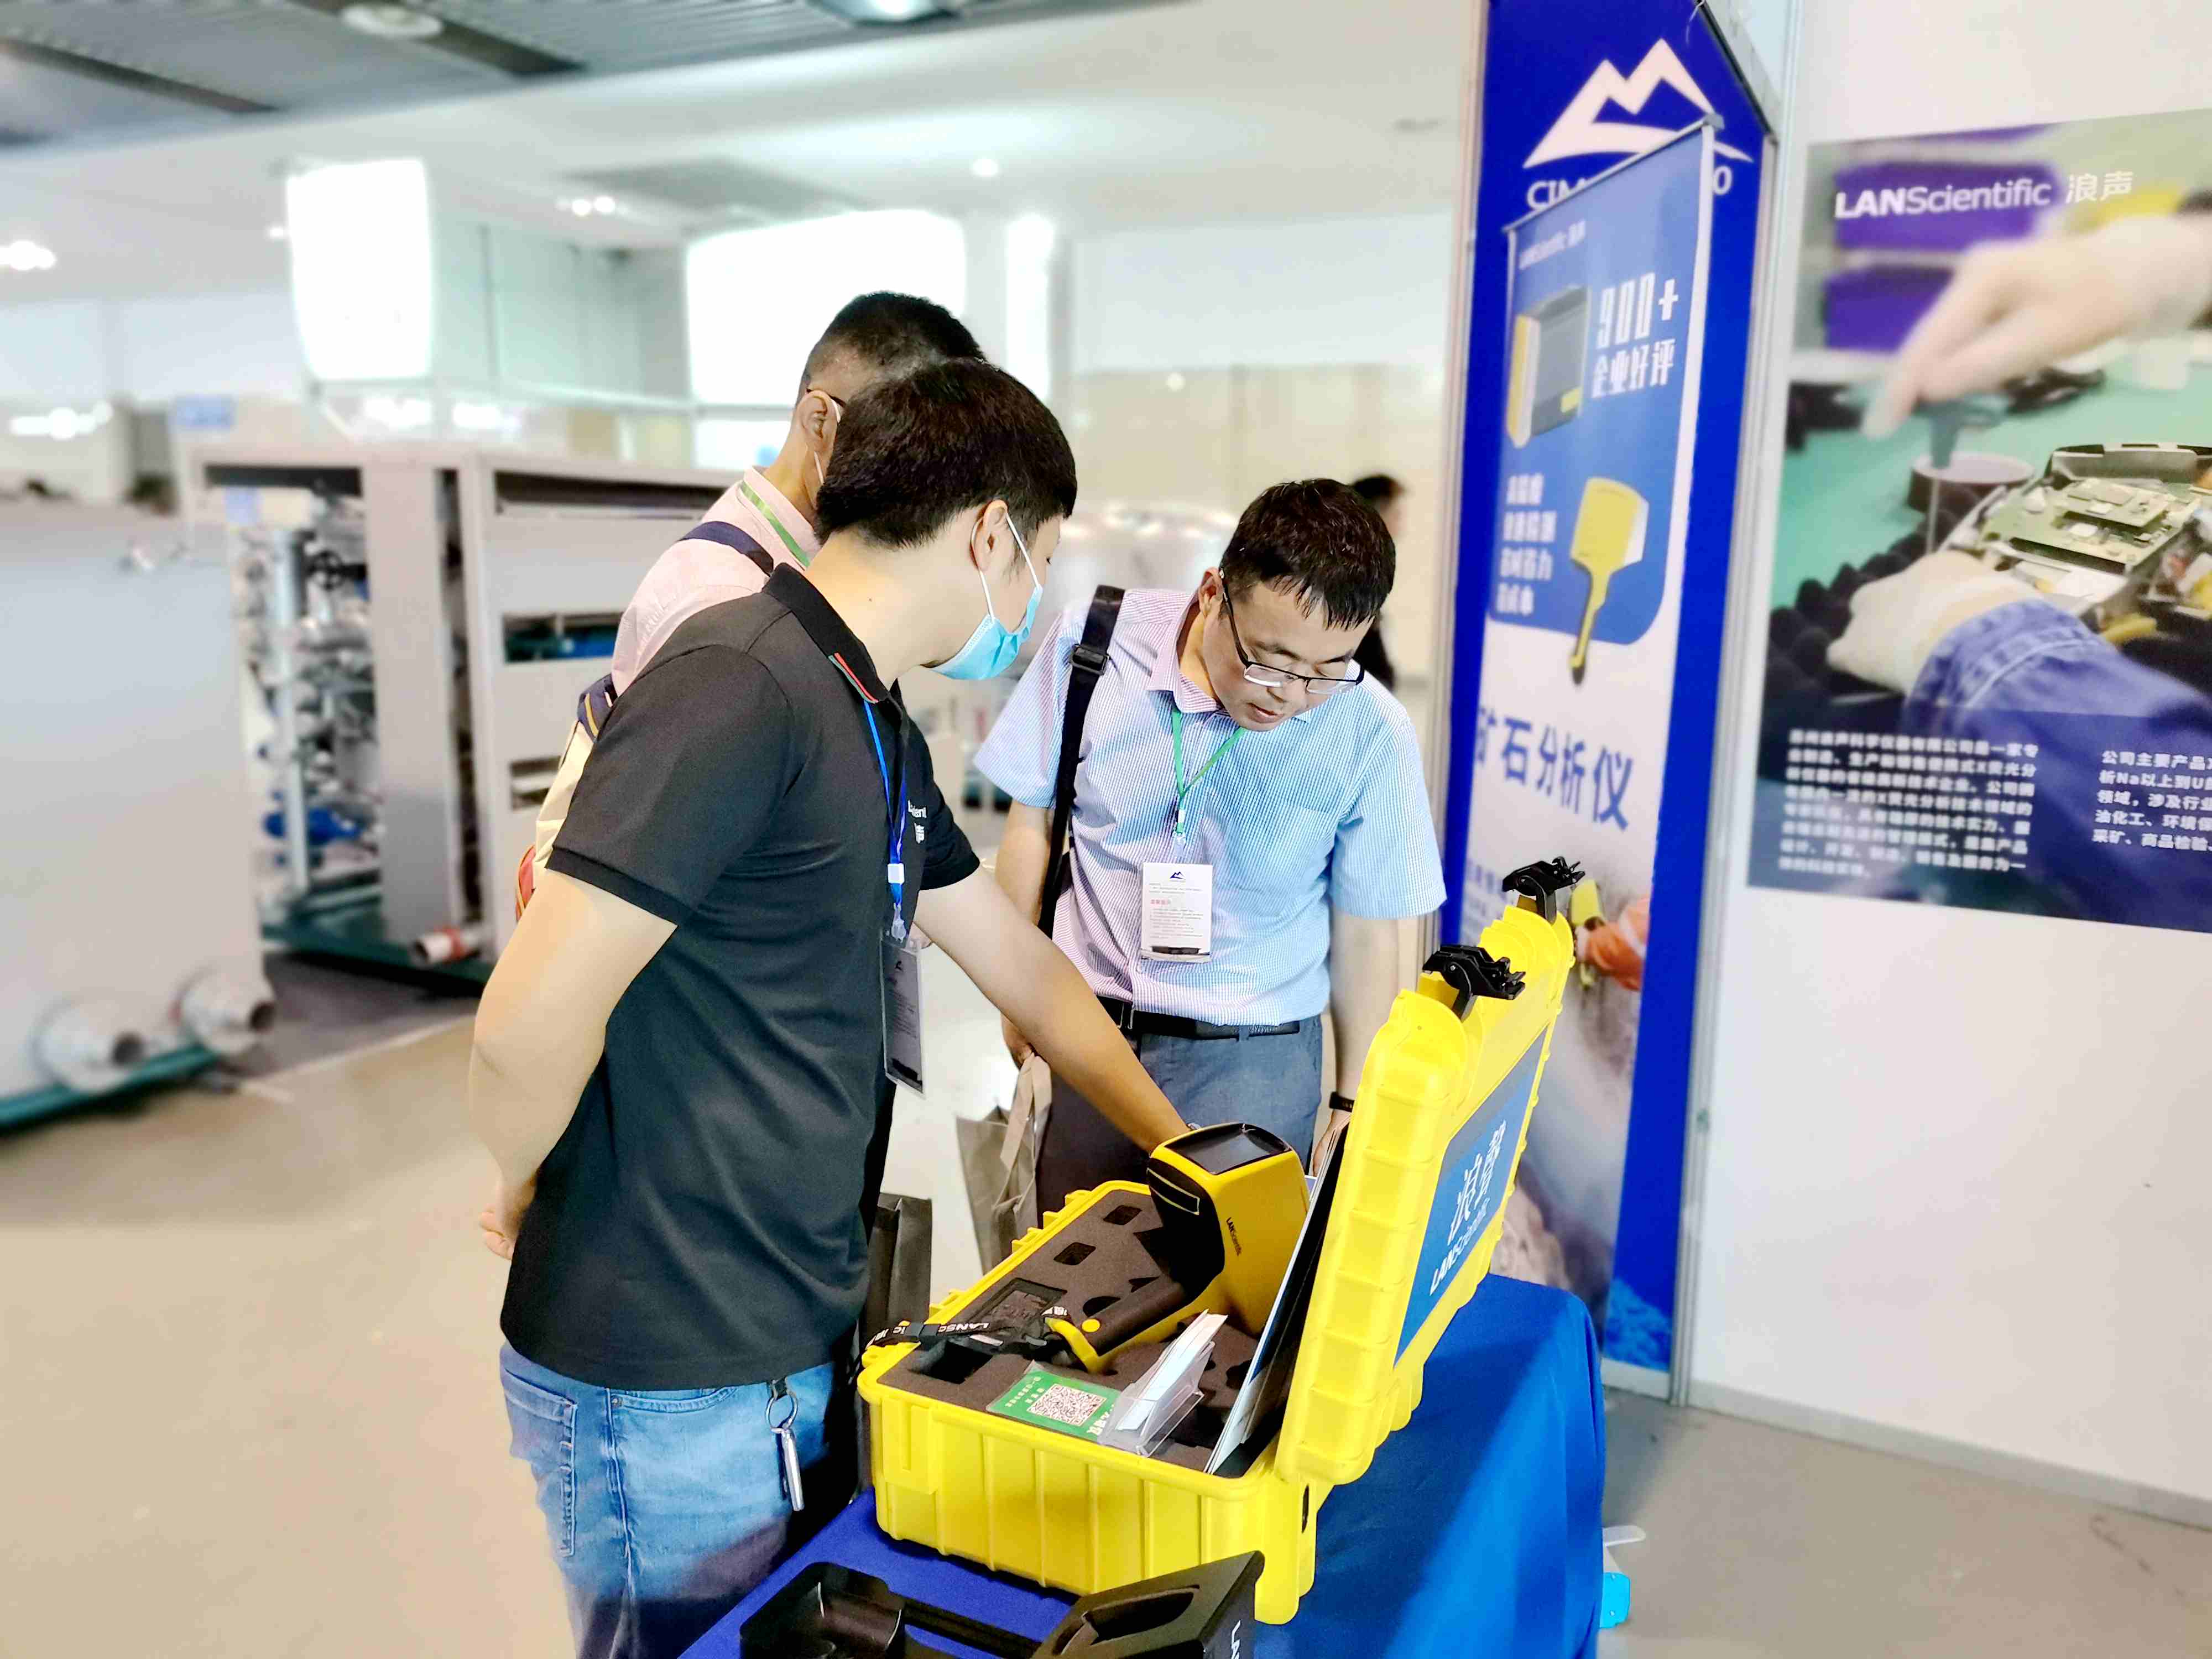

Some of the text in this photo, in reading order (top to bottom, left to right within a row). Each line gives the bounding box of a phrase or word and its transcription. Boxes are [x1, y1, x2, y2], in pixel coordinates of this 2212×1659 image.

[1834, 178, 2052, 218] LANScientific
[2065, 171, 2133, 204] 浪声
[1596, 272, 1679, 350] 900+
